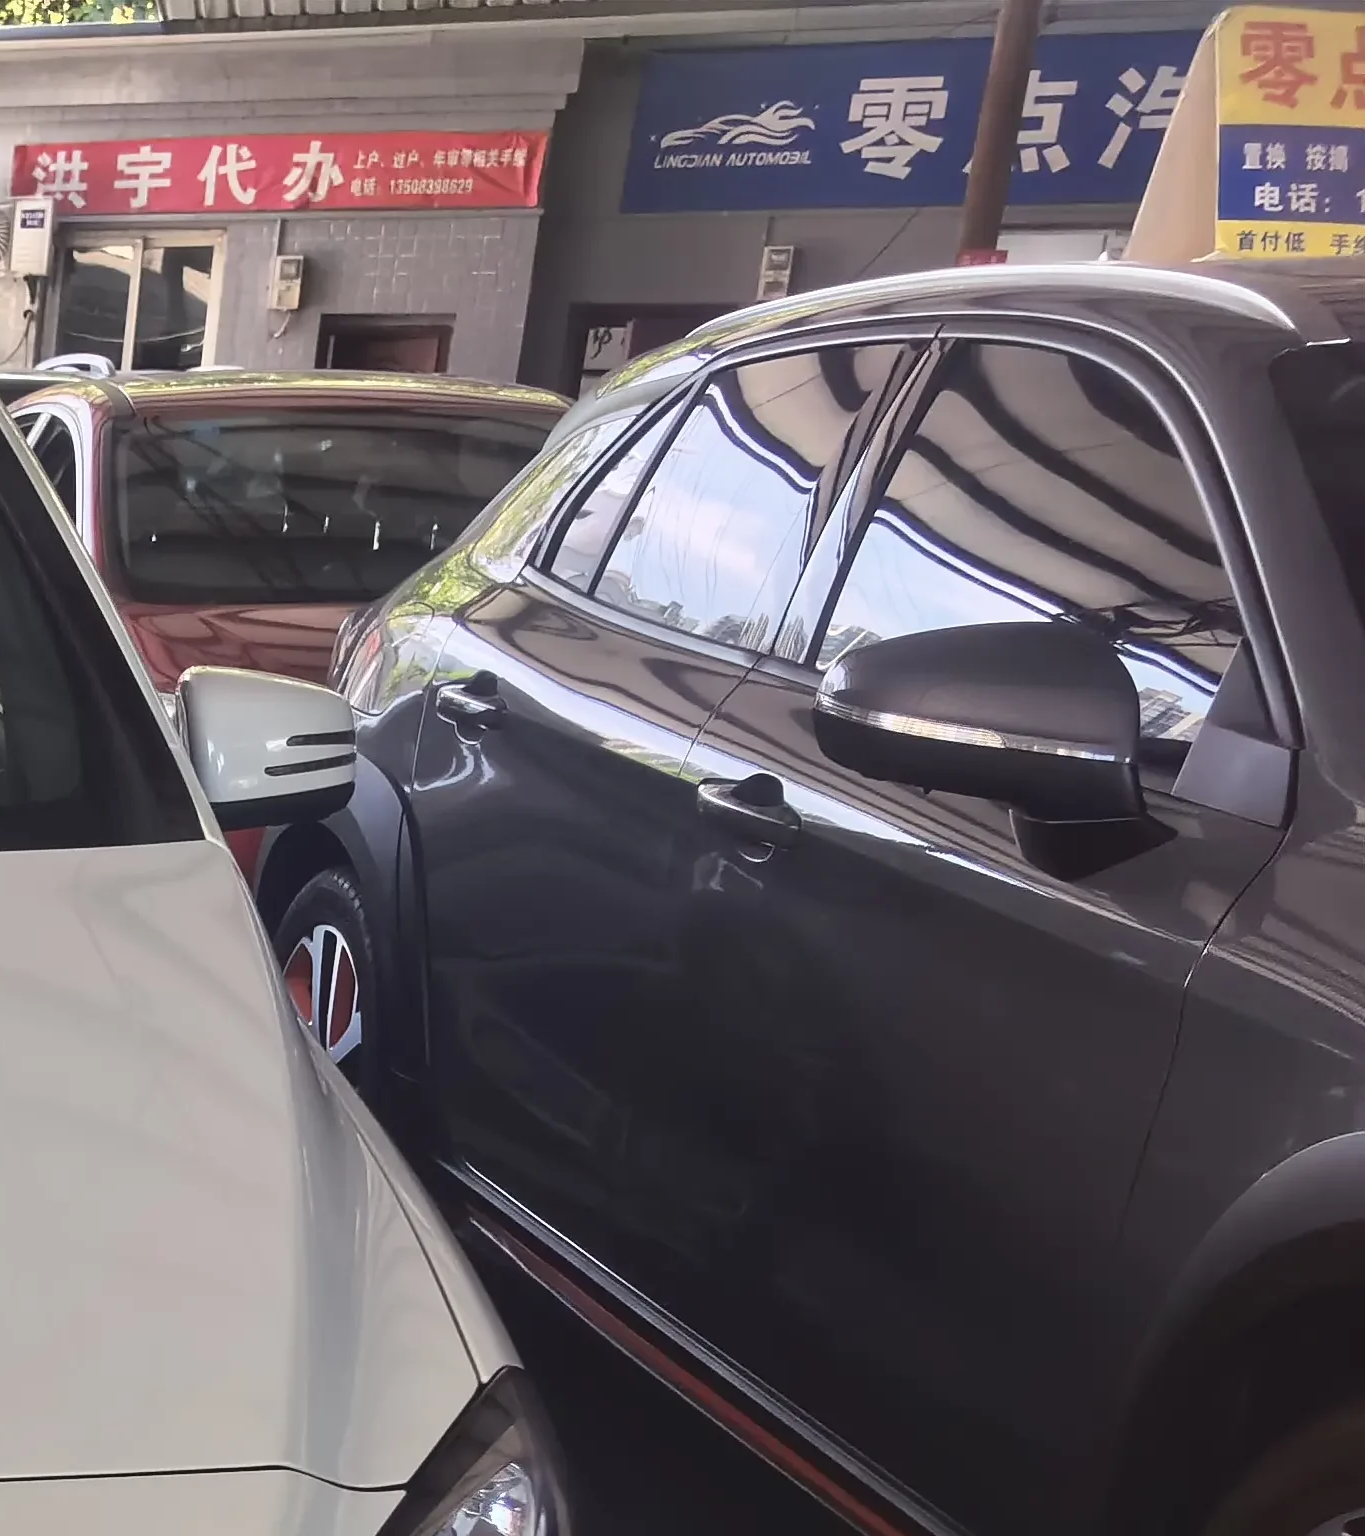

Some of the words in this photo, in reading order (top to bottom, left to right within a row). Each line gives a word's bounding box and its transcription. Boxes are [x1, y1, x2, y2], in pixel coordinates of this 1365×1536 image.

[1242, 142, 1287, 170] 置换
[31, 141, 344, 209] 洪宇代办
[1237, 230, 1306, 252] 首付低
